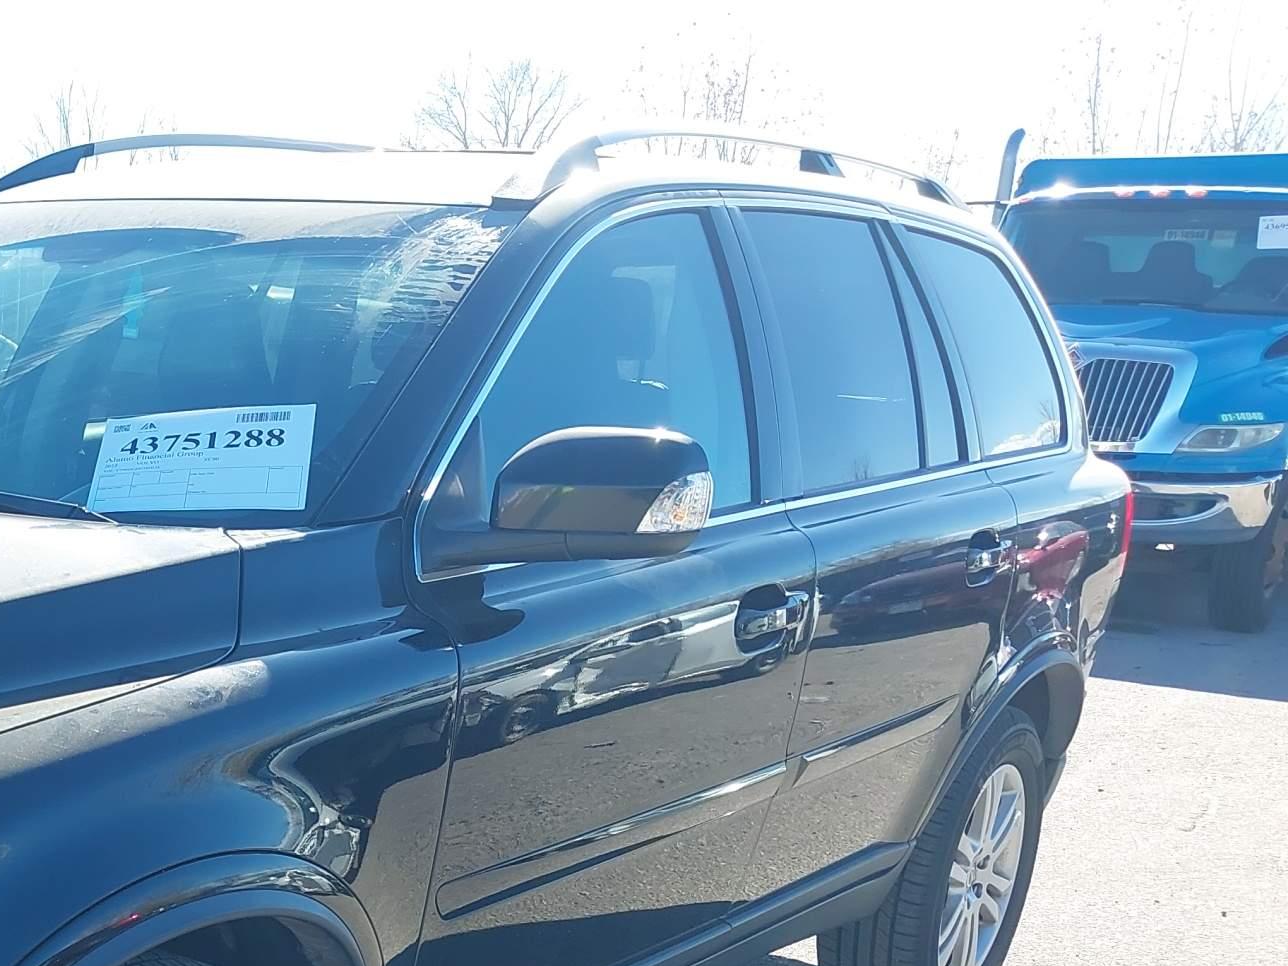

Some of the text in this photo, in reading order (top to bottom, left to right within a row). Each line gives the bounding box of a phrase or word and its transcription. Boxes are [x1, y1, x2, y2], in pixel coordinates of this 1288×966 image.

[120, 428, 285, 454] 43751288
[137, 452, 174, 461] Financial
[177, 450, 204, 458] Group
